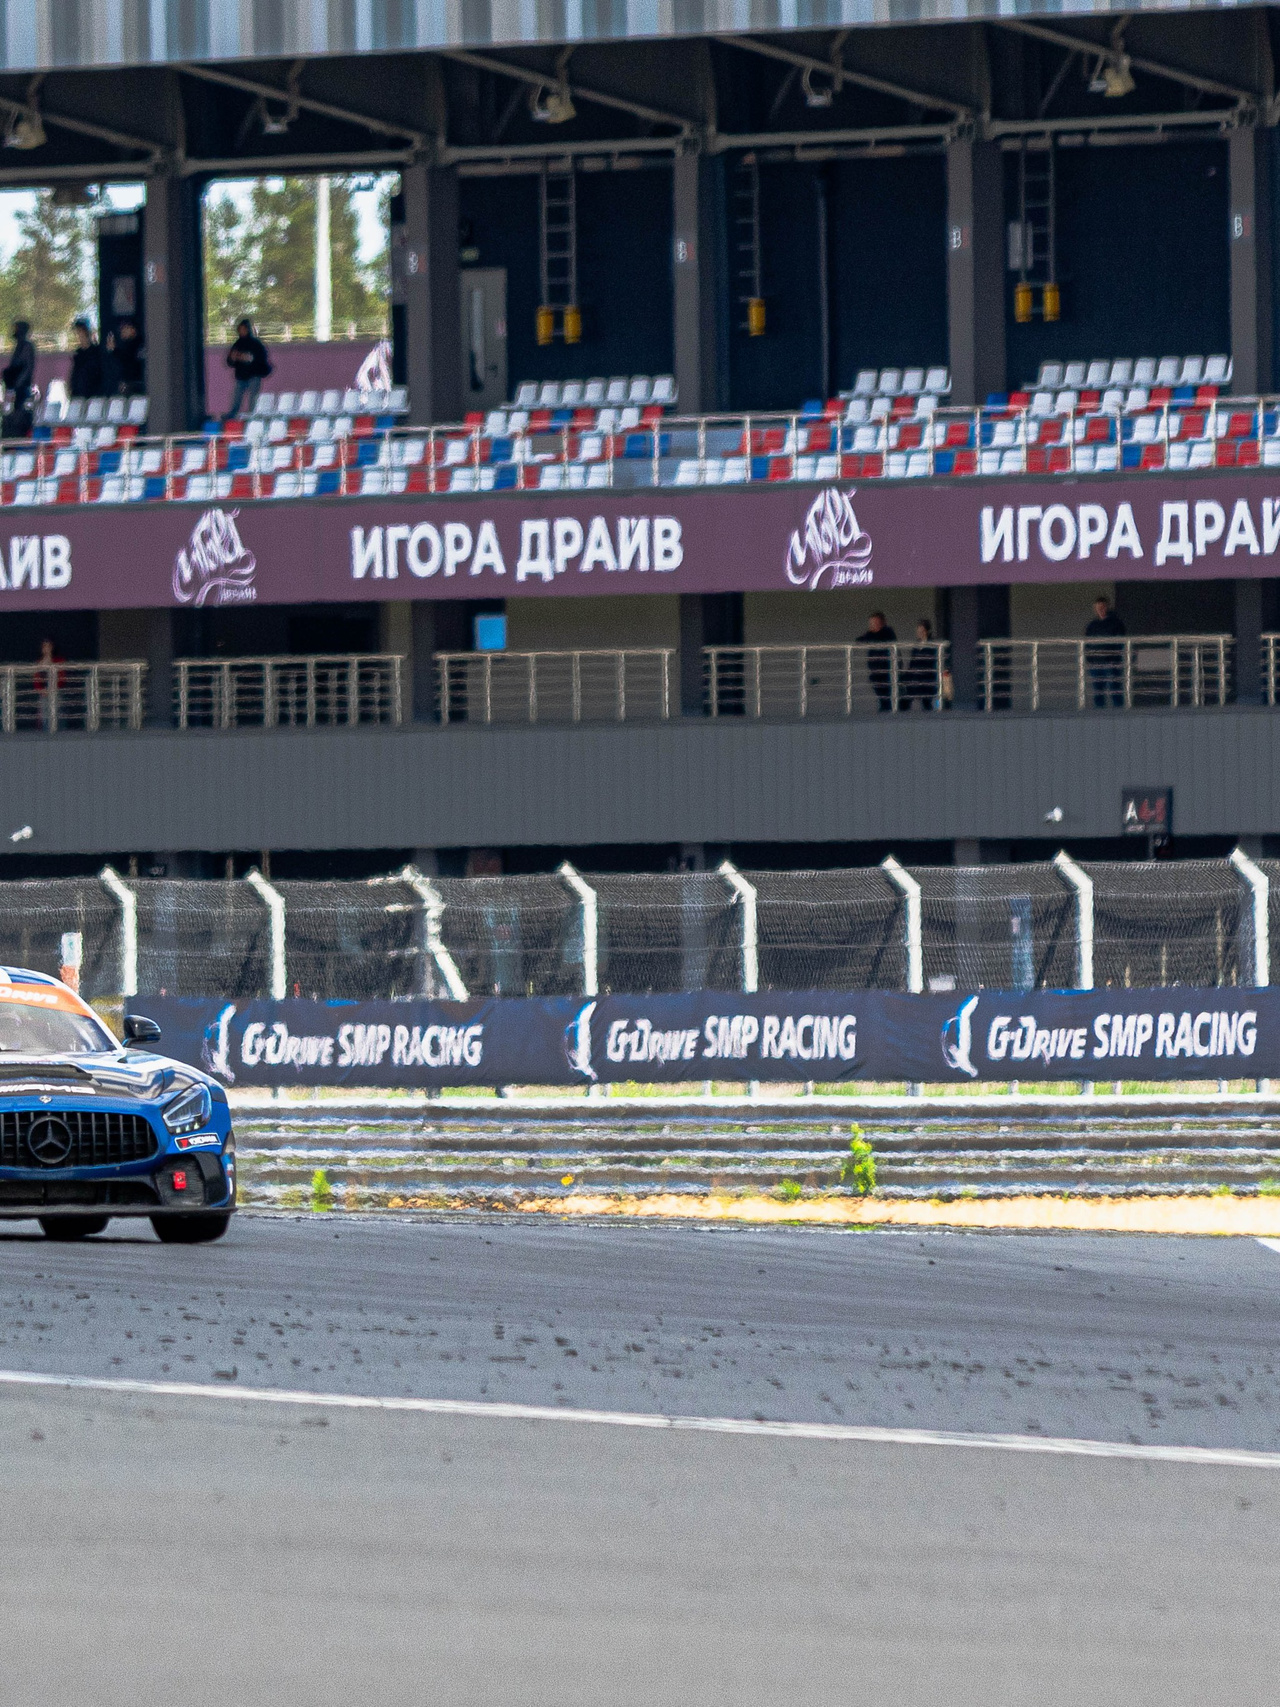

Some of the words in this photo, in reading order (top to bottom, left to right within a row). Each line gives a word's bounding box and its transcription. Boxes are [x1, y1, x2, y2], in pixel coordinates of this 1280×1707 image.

[352, 521, 507, 579] ИГОРА
[517, 515, 684, 582] ДРАЙВ
[981, 503, 1144, 563] ИГОРА
[337, 1024, 391, 1066] SMP
[391, 1024, 483, 1067] RACING
[702, 1014, 759, 1058] SMP
[761, 1014, 857, 1060] RACING
[1092, 1013, 1153, 1058] SMP
[1154, 1010, 1257, 1058] RACING
